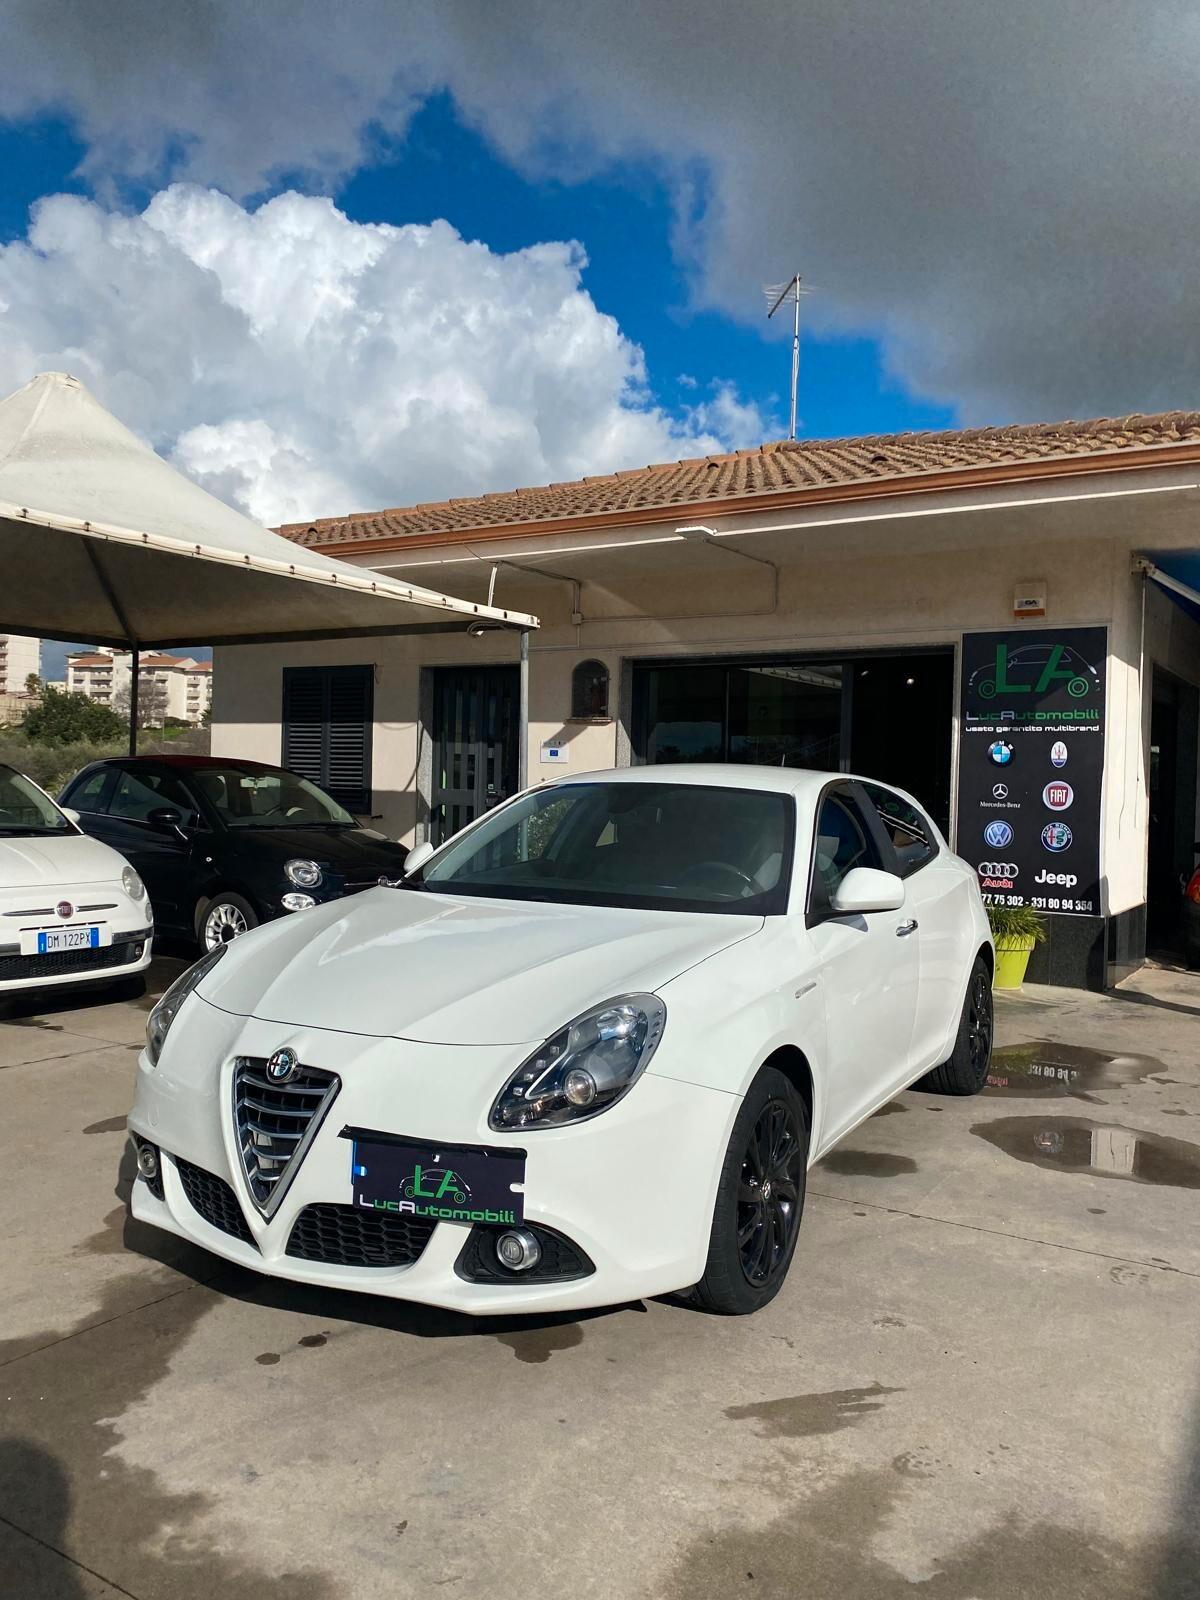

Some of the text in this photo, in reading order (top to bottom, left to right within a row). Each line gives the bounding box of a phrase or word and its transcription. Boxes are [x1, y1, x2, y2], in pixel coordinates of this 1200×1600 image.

[966, 709, 1099, 720] LucAutomobili
[996, 725, 1043, 733] garantito
[1044, 724, 1100, 732] multibrand
[1050, 789, 1067, 803] FIAT
[980, 801, 1021, 809] Mercedes-Benz
[982, 878, 1013, 888] Audi
[1034, 869, 1078, 888] Jeep
[994, 894, 1005, 905] 75
[1007, 895, 1024, 906] 302
[1031, 897, 1046, 908] 331
[1048, 898, 1060, 909] 80
[1061, 899, 1073, 910] 94
[1075, 900, 1093, 911] 354
[47, 935, 60, 949] DM
[63, 932, 91, 947] 122PX
[359, 1194, 516, 1225] LucAutomobili
